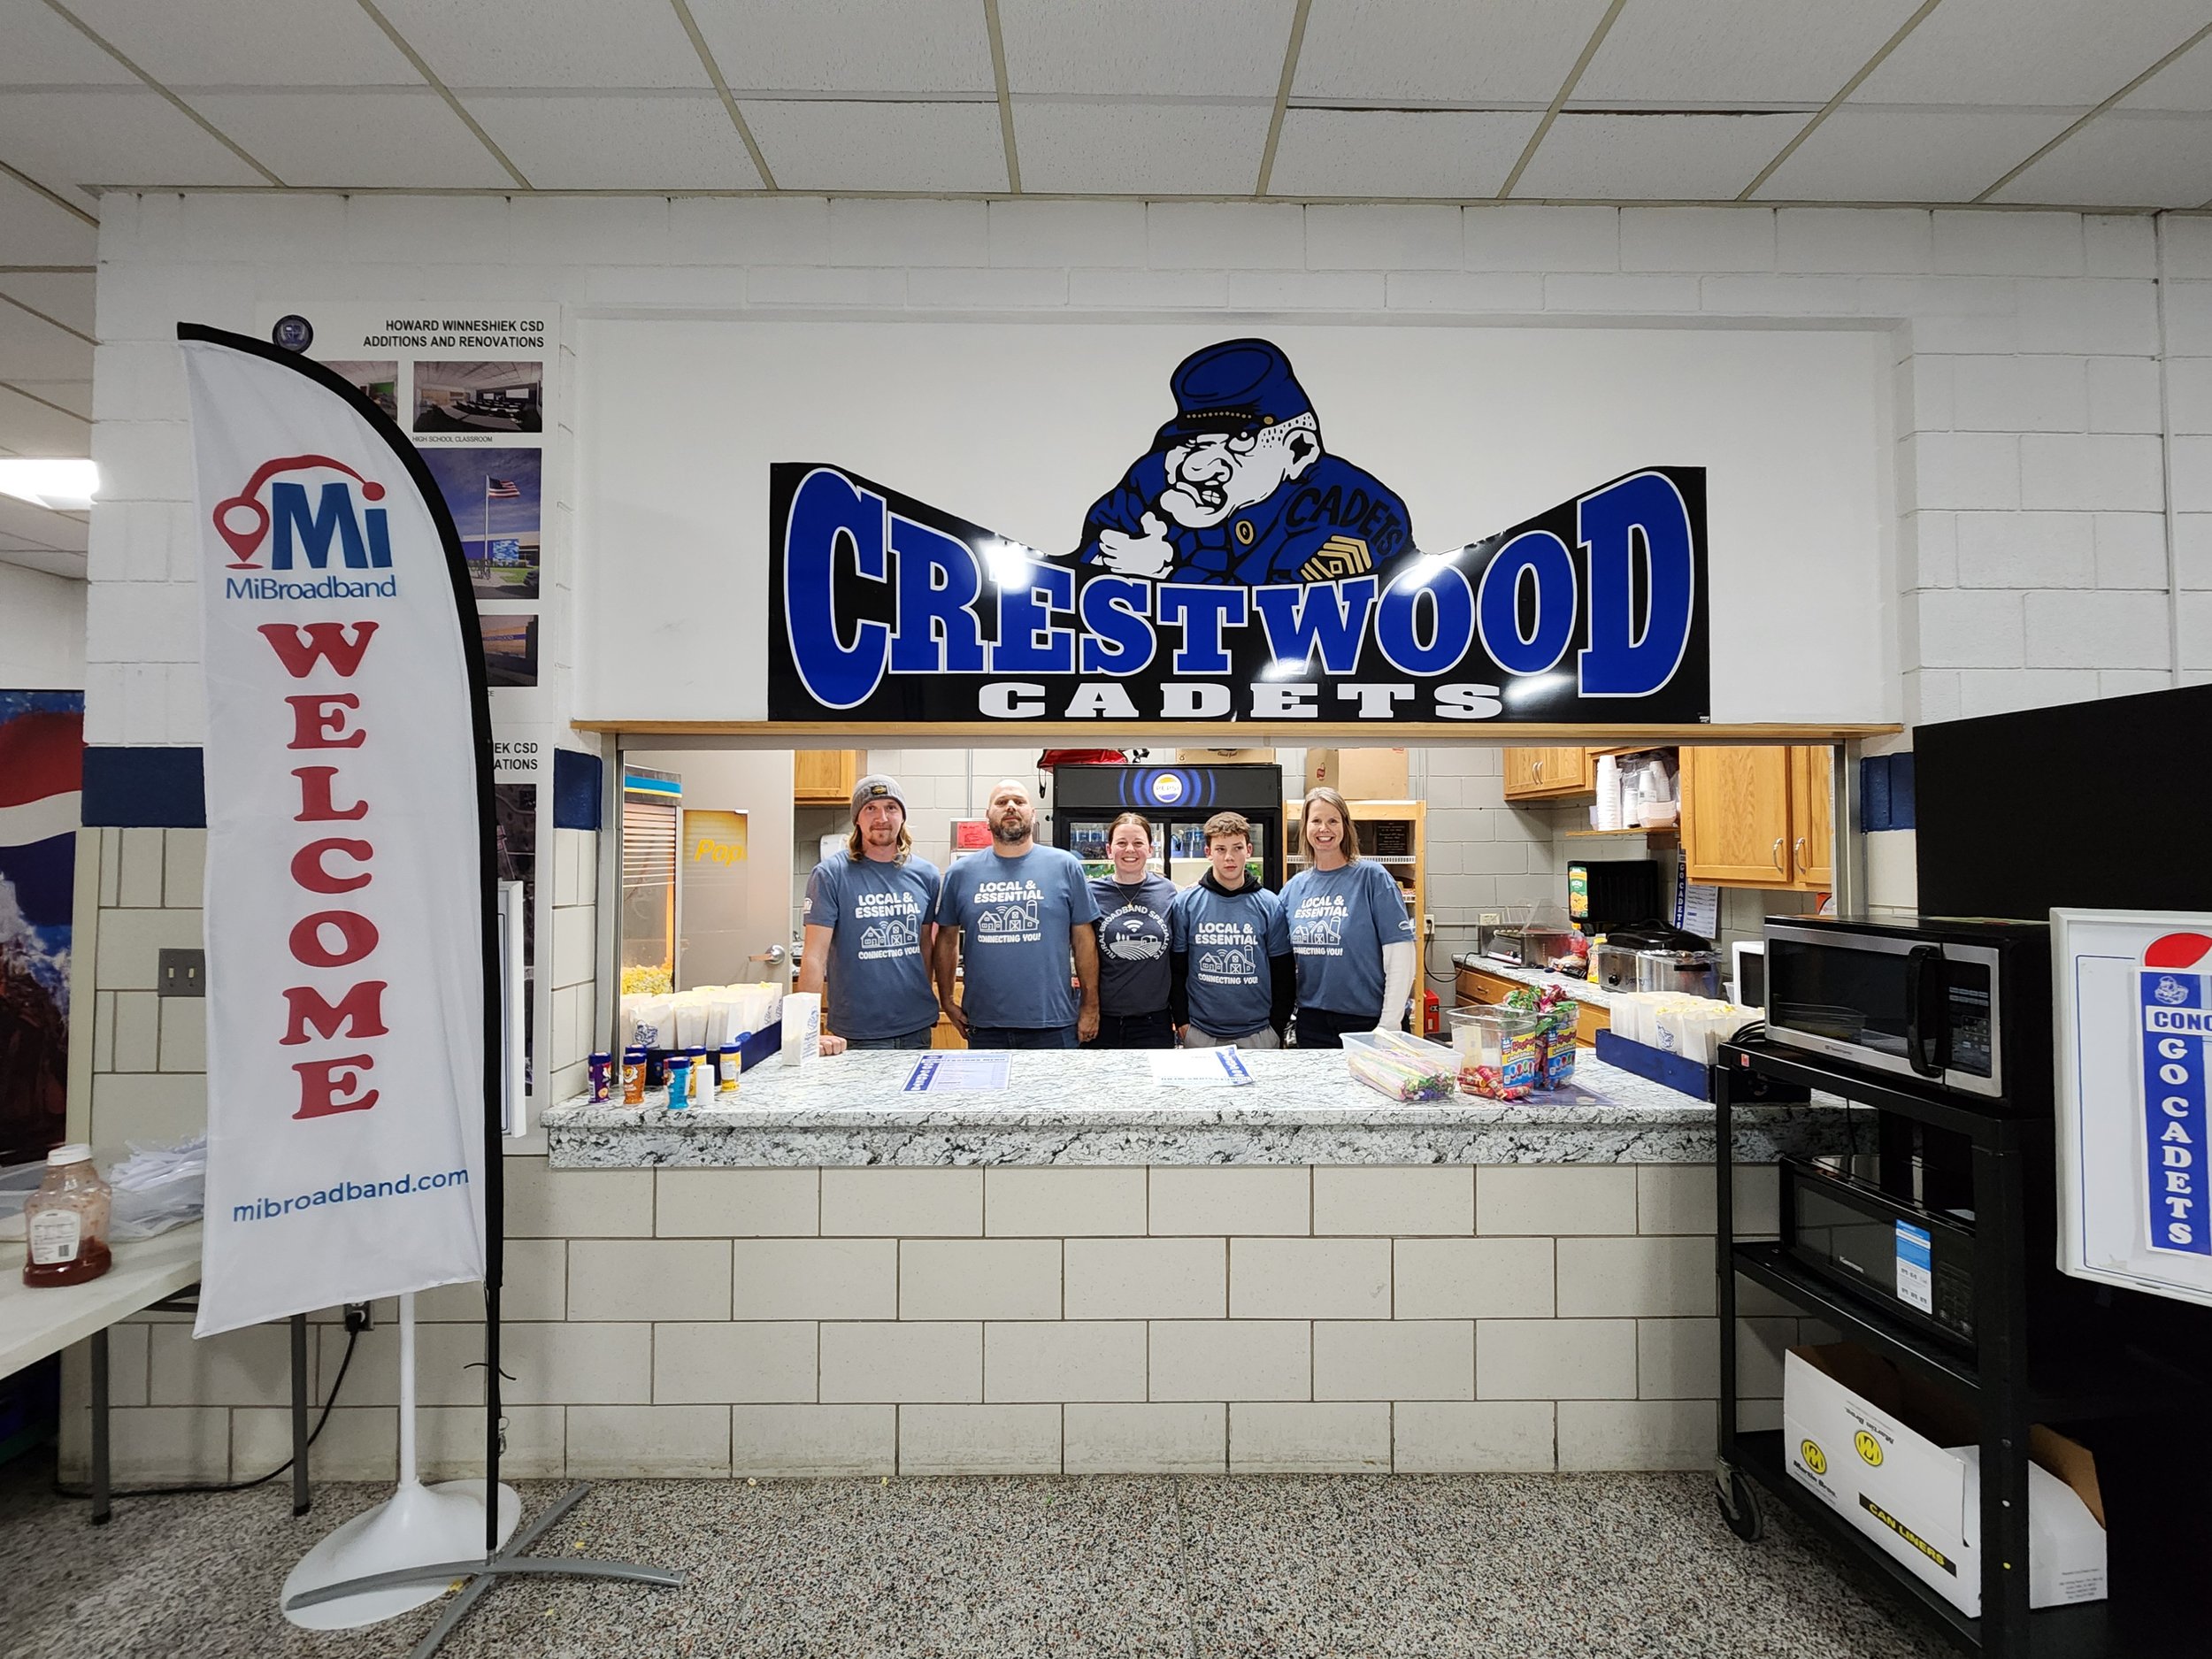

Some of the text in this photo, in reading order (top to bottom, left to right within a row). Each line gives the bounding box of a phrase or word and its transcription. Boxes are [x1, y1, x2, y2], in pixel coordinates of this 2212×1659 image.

[386, 319, 544, 332] HOWARD WINNESHIEK CSD
[364, 335, 544, 348] ADDITIONS AND RENOVATIONS
[271, 480, 393, 571] Mi
[1286, 485, 1403, 556] CADETS
[226, 574, 396, 600] MiBroadband
[784, 467, 1694, 710] CRESTWOOD
[979, 682, 1502, 718] CADETS
[513, 742, 538, 754] CSD
[257, 621, 389, 1120] WELCOME
[979, 879, 1037, 893] LOCAL &
[858, 892, 913, 907] LOCAL &
[974, 889, 1044, 903] ESSENTIAL
[1302, 895, 1345, 909] LOCAL &
[855, 902, 921, 918] ESSENTIAL
[1294, 906, 1349, 918] ESSENTIAL
[1676, 881, 1686, 930] CADETS
[1098, 904, 1171, 960] RURAL BROADBAND SPECIALISTS
[1198, 923, 1253, 933] LOCAL &
[977, 932, 1041, 943] CONNECTING YOU!
[1194, 933, 1258, 945] ESSENTIAL
[857, 945, 920, 960] CONNECTING YOU!
[1326, 947, 1343, 956] YOU!
[1197, 972, 1258, 985] CONNECTING YOU!
[2157, 1037, 2193, 1245] GO CADETS
[232, 1169, 470, 1223] mibroadband.com
[1793, 1459, 1817, 1483] Martin
[1869, 1503, 1945, 1566] CAN LINERS
